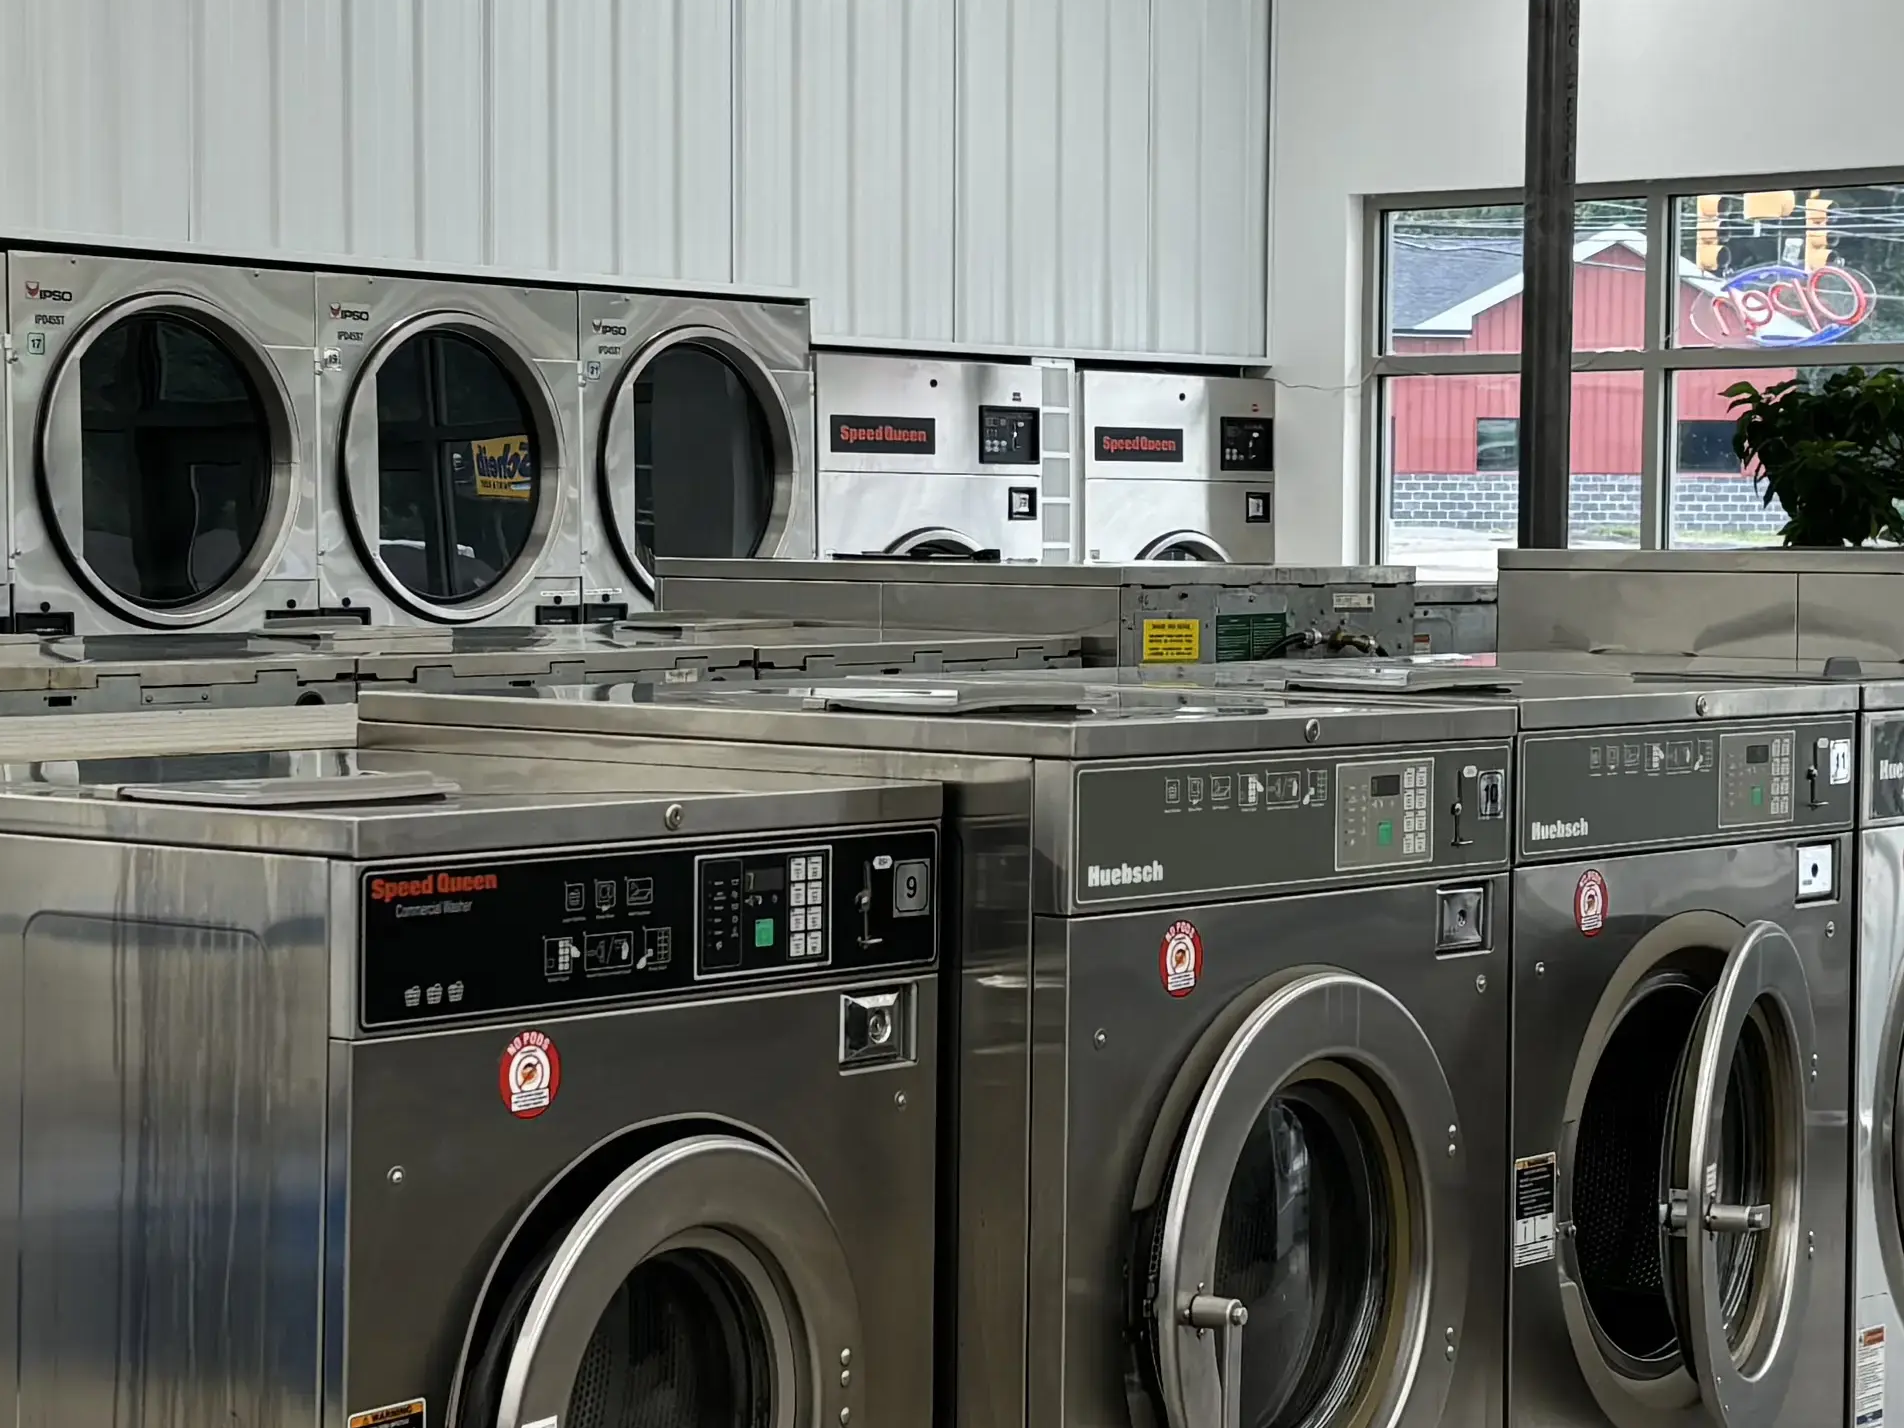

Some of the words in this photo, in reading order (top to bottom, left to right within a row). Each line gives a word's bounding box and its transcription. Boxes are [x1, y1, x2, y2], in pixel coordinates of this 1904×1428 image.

[31, 338, 42, 349] 17
[839, 424, 884, 444] Speed
[884, 425, 927, 443] Queen
[1103, 435, 1140, 453] Speed
[1484, 783, 1499, 805] 10
[1532, 817, 1589, 841] Huebsch
[1087, 859, 1164, 887] Huebsch
[371, 873, 434, 903] Speed
[436, 872, 498, 894] Queen
[906, 876, 917, 899] 9
[506, 1036, 523, 1057] NO
[523, 1031, 551, 1051] PODS
